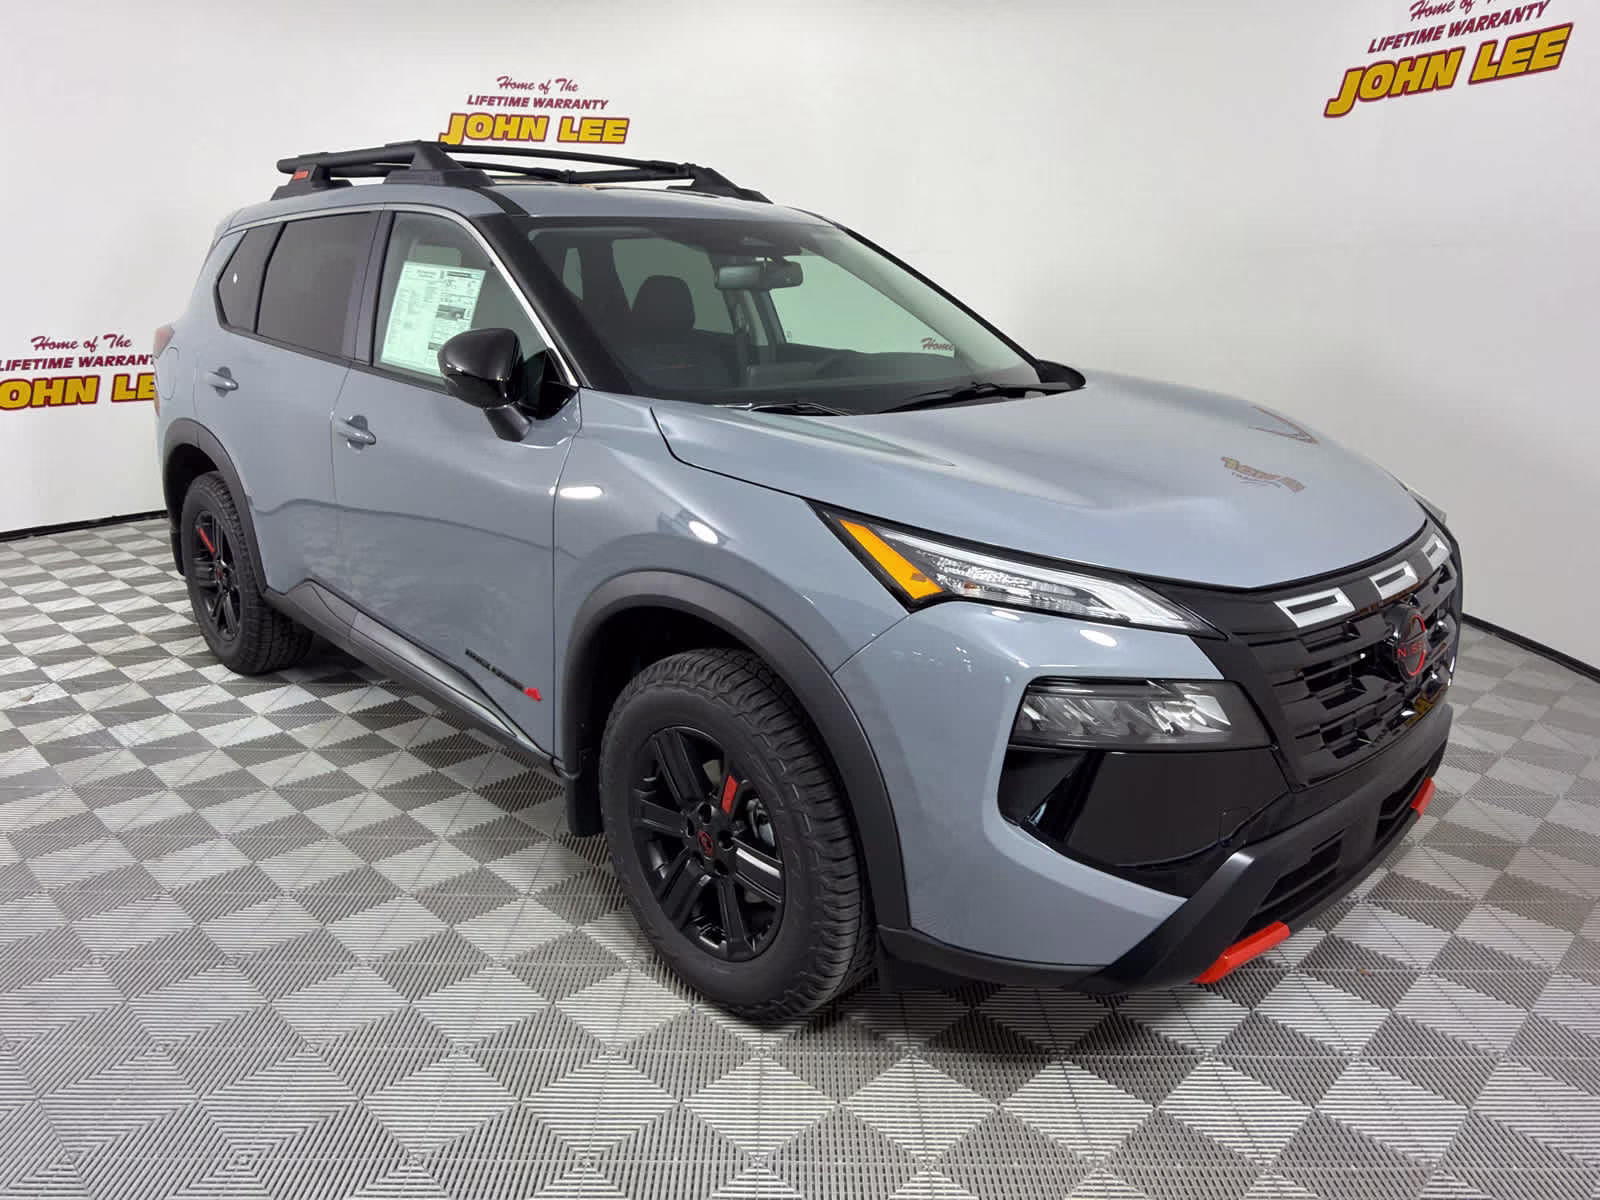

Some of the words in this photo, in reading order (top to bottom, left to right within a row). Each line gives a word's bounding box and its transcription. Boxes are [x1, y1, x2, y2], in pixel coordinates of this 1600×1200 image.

[1409, 0, 1455, 21] Home
[1368, 25, 1444, 54] LIFETIME
[1448, 0, 1549, 38] WARRANTY
[1324, 46, 1466, 118] JOHN
[1468, 22, 1574, 85] LEE
[496, 76, 535, 91] Home
[538, 79, 551, 95] of
[555, 78, 579, 93] The
[466, 94, 530, 108] LIFETIME
[532, 97, 608, 110] WARRANTY
[439, 112, 550, 145] JOHN
[557, 115, 630, 144] LEE
[30, 335, 78, 351] Home
[83, 336, 98, 352] of
[103, 333, 132, 348] The
[0, 357, 73, 371] LIFETIME
[78, 354, 154, 368] WARRANT
[0, 375, 101, 410] OHN
[111, 372, 155, 402] LE
